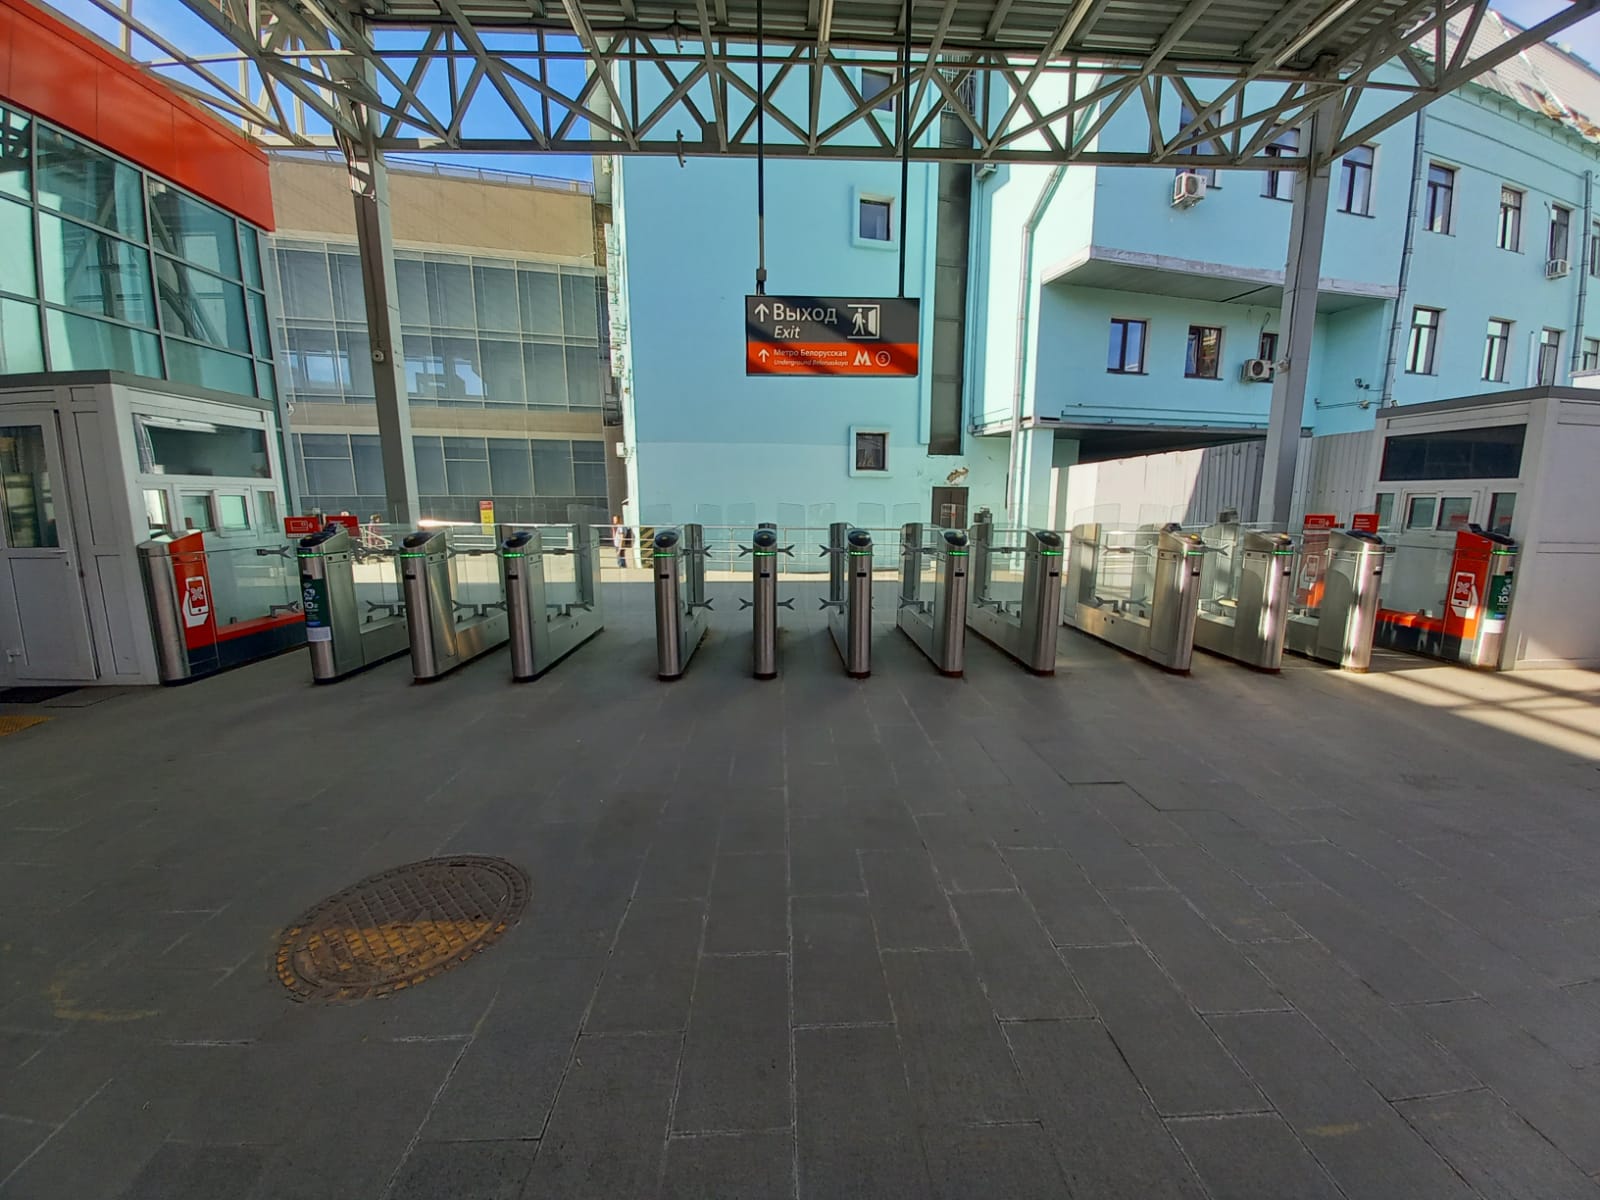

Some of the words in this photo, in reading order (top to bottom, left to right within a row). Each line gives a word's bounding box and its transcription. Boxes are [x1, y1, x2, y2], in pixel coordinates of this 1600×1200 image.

[773, 303, 838, 325] Выход
[774, 325, 800, 339] Exit
[773, 349, 799, 358] Метро
[800, 349, 848, 358] Белорусская
